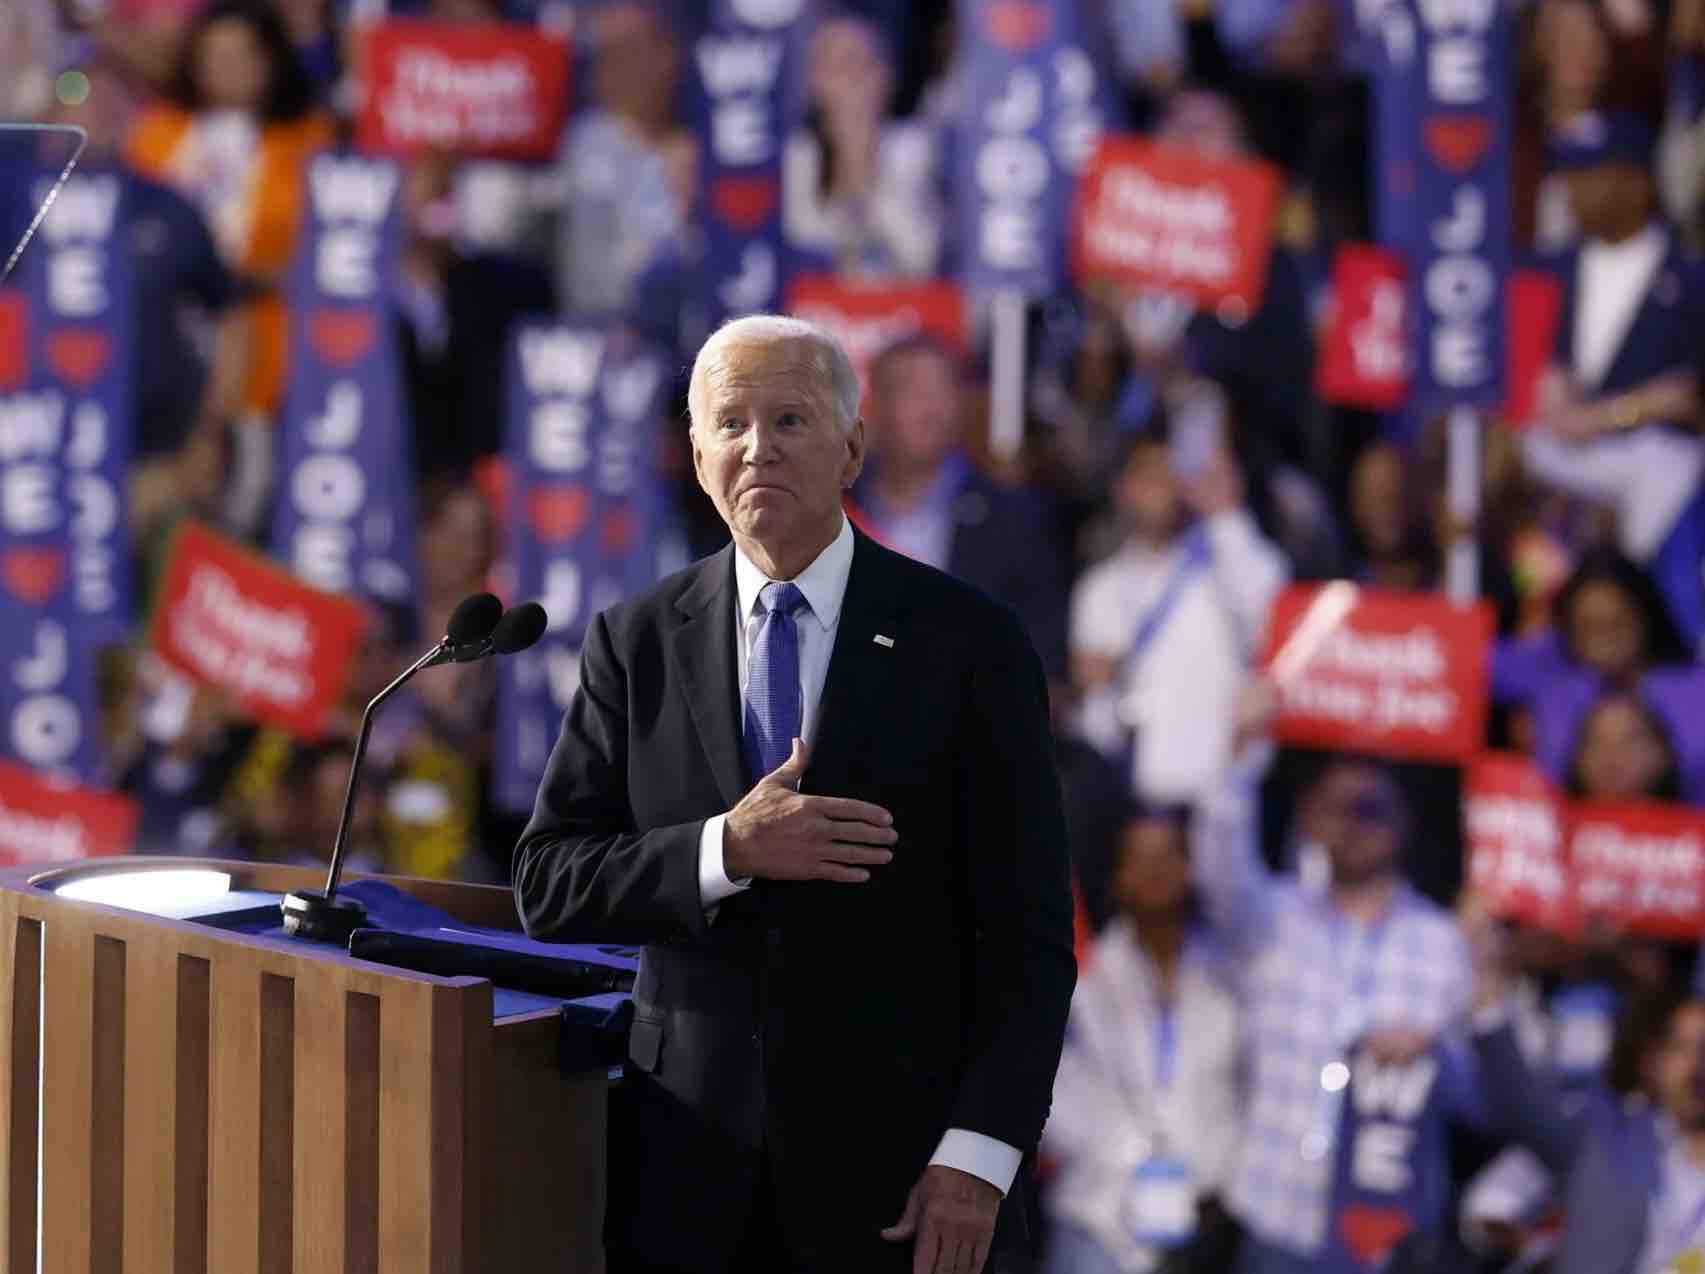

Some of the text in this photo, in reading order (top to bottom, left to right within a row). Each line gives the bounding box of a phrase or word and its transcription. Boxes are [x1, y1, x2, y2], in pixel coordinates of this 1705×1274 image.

[697, 34, 784, 166] WE
[974, 68, 1052, 270] JOE
[1424, 184, 1496, 388] JOE
[292, 156, 398, 591] WE JOE
[518, 328, 602, 472] WE
[1350, 1056, 1437, 1194] WE
